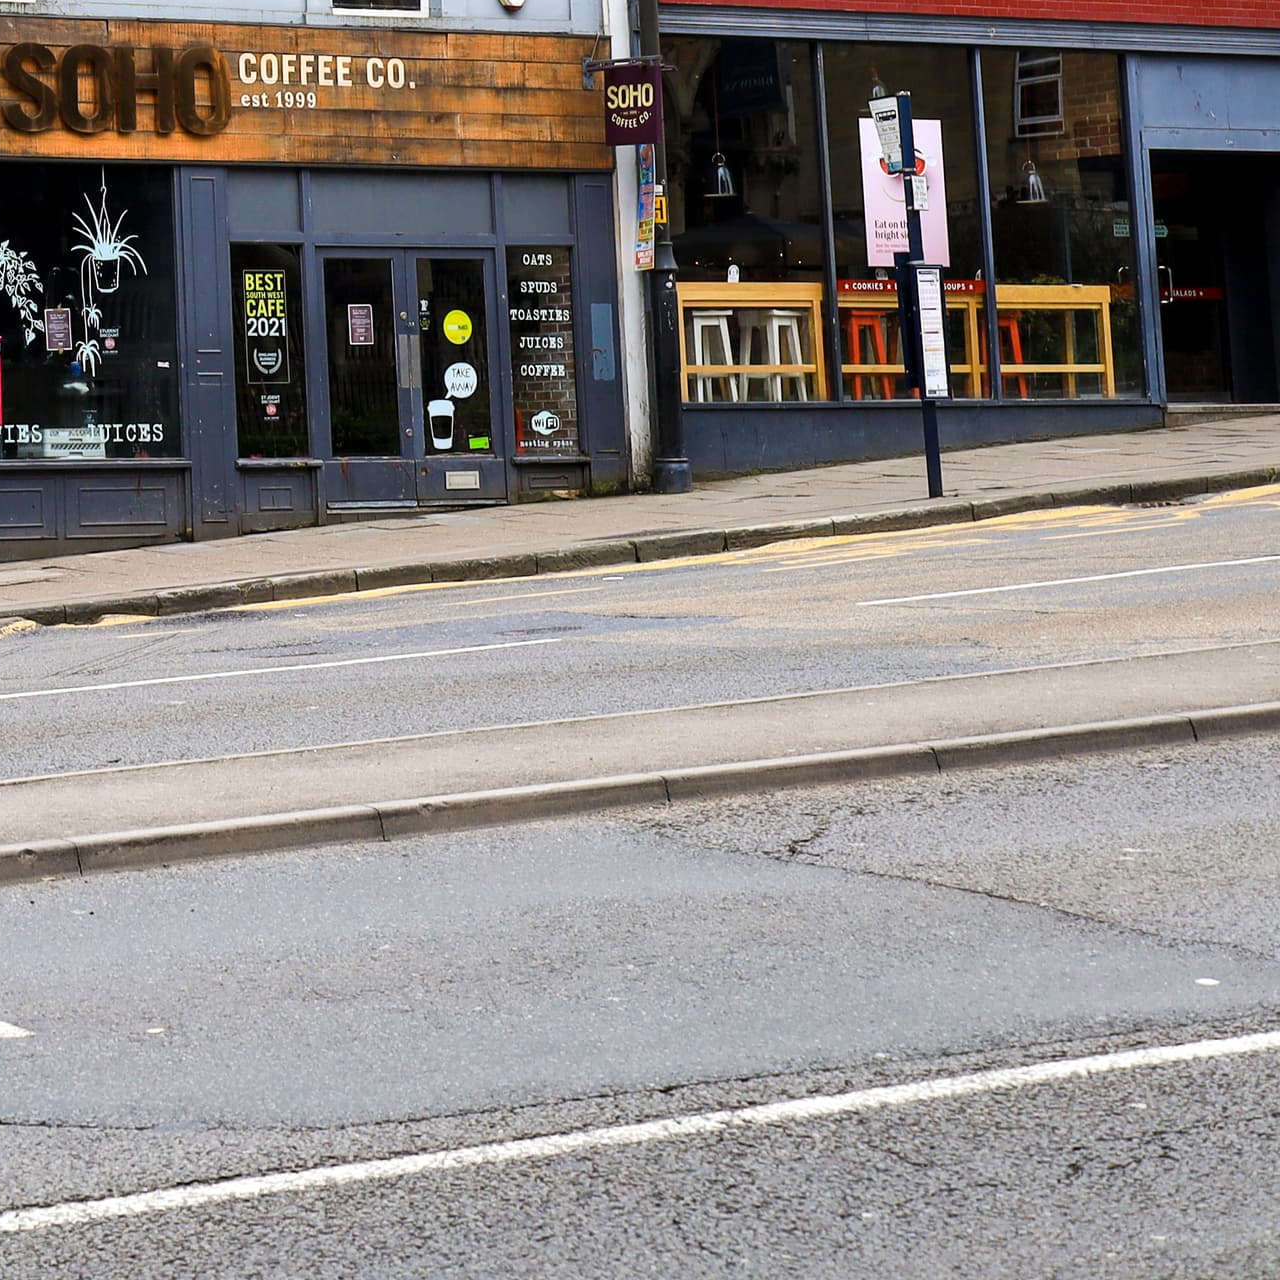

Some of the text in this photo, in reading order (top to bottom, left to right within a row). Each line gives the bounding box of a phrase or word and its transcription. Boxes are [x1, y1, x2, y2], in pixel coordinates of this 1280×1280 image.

[238, 52, 417, 89] COFFEE CO.
[2, 42, 232, 136] SOHO
[607, 82, 654, 109] SOHO
[240, 91, 317, 109] est 1999
[611, 113, 638, 128] COFFEE
[875, 219, 887, 229] Eat
[875, 229, 900, 241] bright
[522, 253, 552, 266] OATS
[245, 273, 283, 291] BEST
[520, 281, 558, 294] SPUDS
[852, 281, 884, 290] COOKIES
[246, 291, 284, 299] SOUTH WEST
[246, 299, 285, 317] CAFE
[510, 308, 570, 321] TOASTIES
[247, 317, 286, 337] 2021
[519, 336, 564, 349] JUICES
[451, 367, 471, 378] TAKE
[520, 365, 566, 377] COFFEE
[450, 381, 474, 393] AWAY
[87, 422, 164, 444] JUICES
